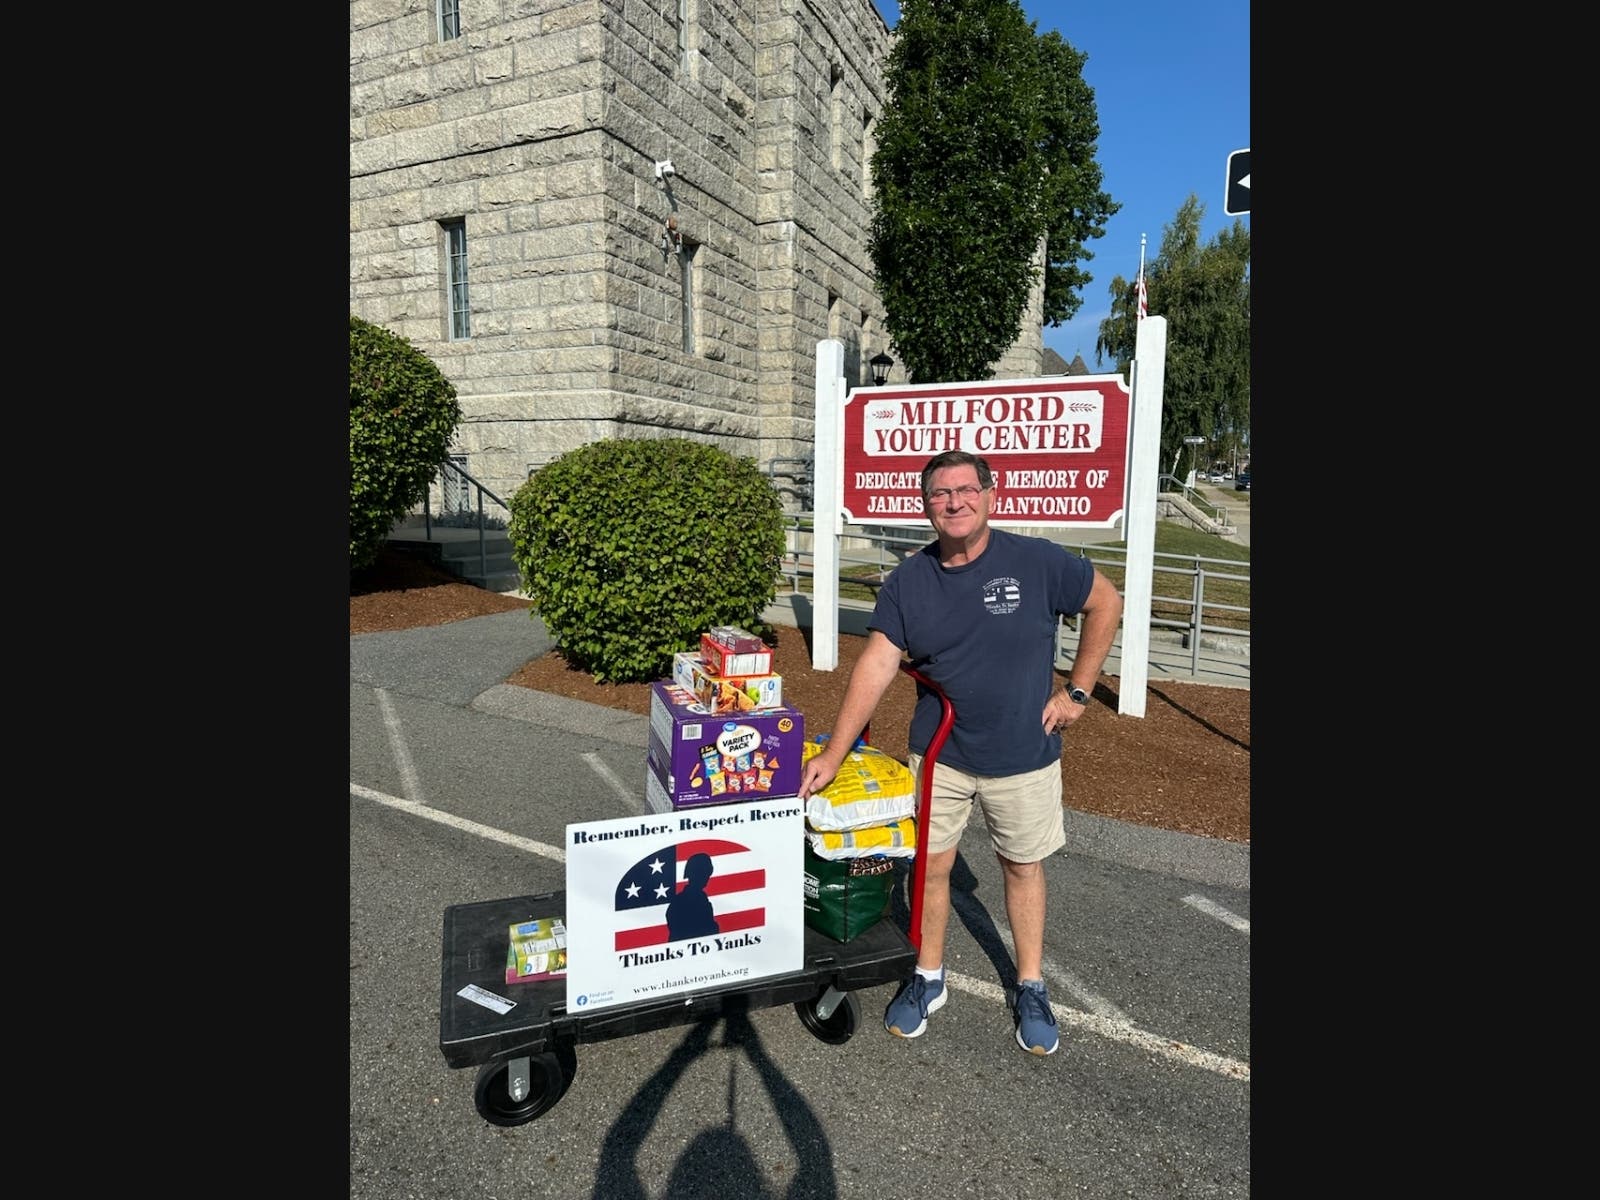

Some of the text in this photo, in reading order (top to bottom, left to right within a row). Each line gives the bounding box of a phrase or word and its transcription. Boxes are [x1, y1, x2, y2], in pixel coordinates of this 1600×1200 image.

[900, 396, 1065, 426] MILFORD
[875, 423, 1091, 452] YOUTH CENTER
[855, 471, 922, 490] DEDICATE
[1005, 470, 1080, 489] MEMORY
[1086, 470, 1109, 489] OF
[867, 496, 1091, 515] JAMES iANTONIO
[781, 720, 791, 728] 40
[722, 732, 755, 747] VARIETY
[729, 741, 749, 752] PACK
[573, 807, 800, 844] Remember, Respect, Revere
[619, 934, 762, 968] Thanks To Yanks
[633, 967, 749, 995] www.thankstoyanks.org
